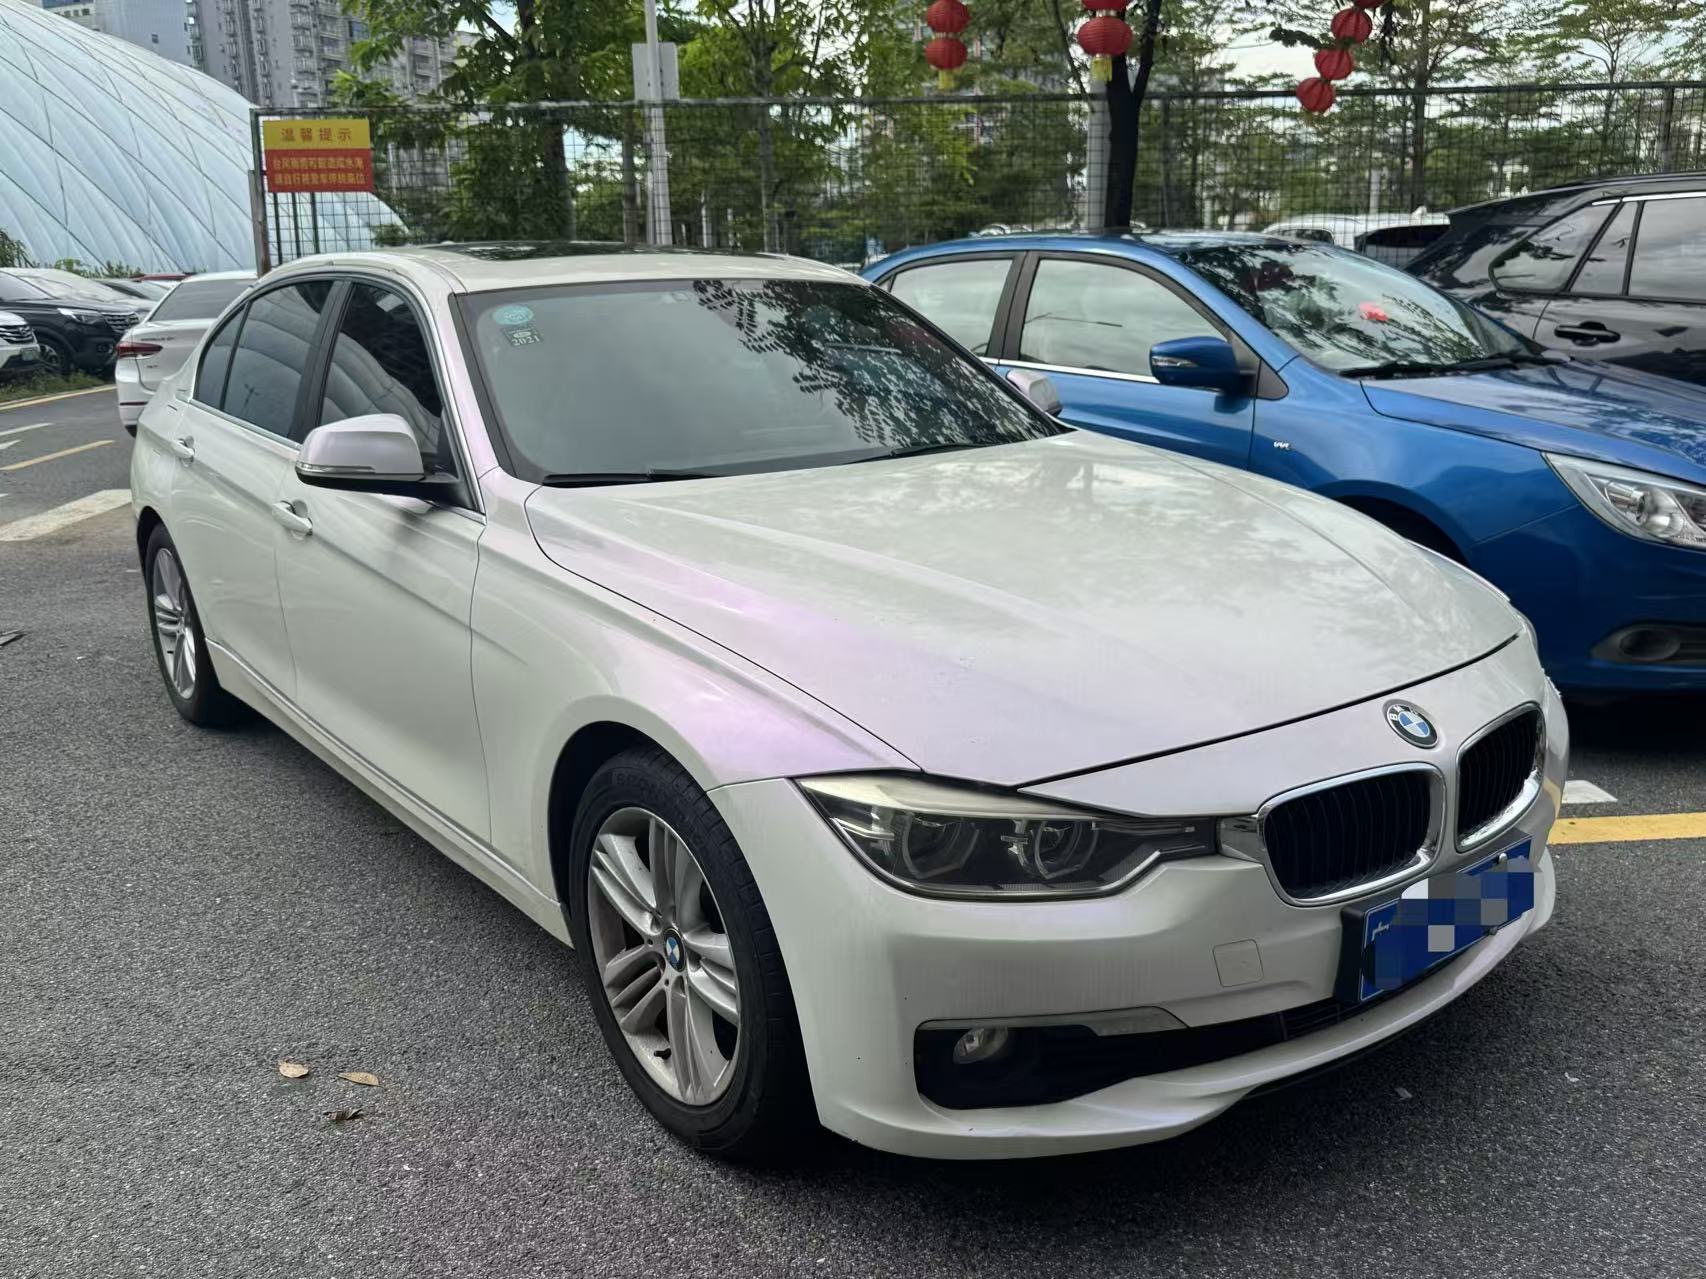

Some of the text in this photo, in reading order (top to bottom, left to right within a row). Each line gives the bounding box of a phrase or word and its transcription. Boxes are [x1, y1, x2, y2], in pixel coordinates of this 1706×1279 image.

[281, 127, 352, 142] 温馨提示
[511, 335, 540, 346] 2021
